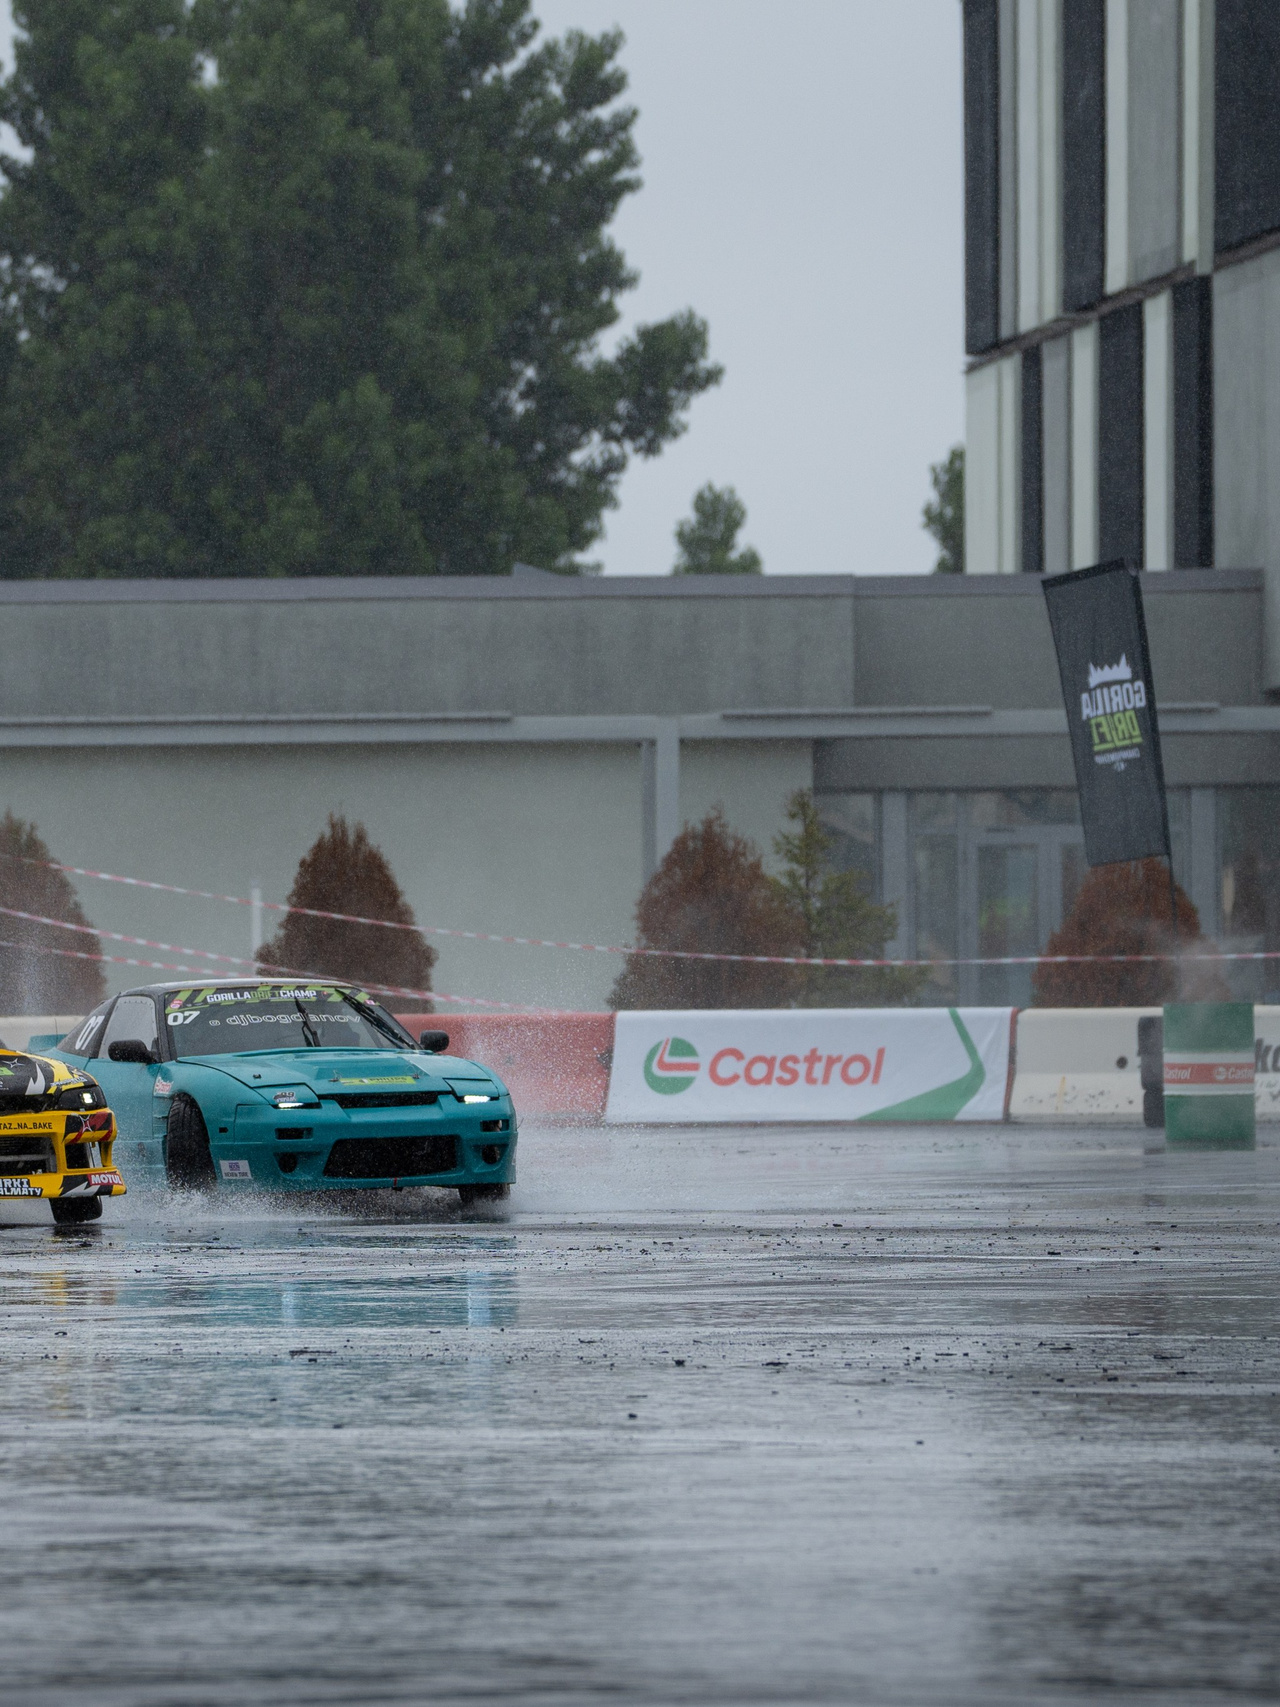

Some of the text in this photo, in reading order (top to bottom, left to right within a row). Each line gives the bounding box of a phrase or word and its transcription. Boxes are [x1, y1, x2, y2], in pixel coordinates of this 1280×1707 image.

[167, 1011, 200, 1026] 07
[226, 1013, 361, 1026] djbogdanov
[75, 1015, 105, 1050] 07
[708, 1047, 886, 1086] Castrol
[91, 1174, 122, 1184] MOTUL
